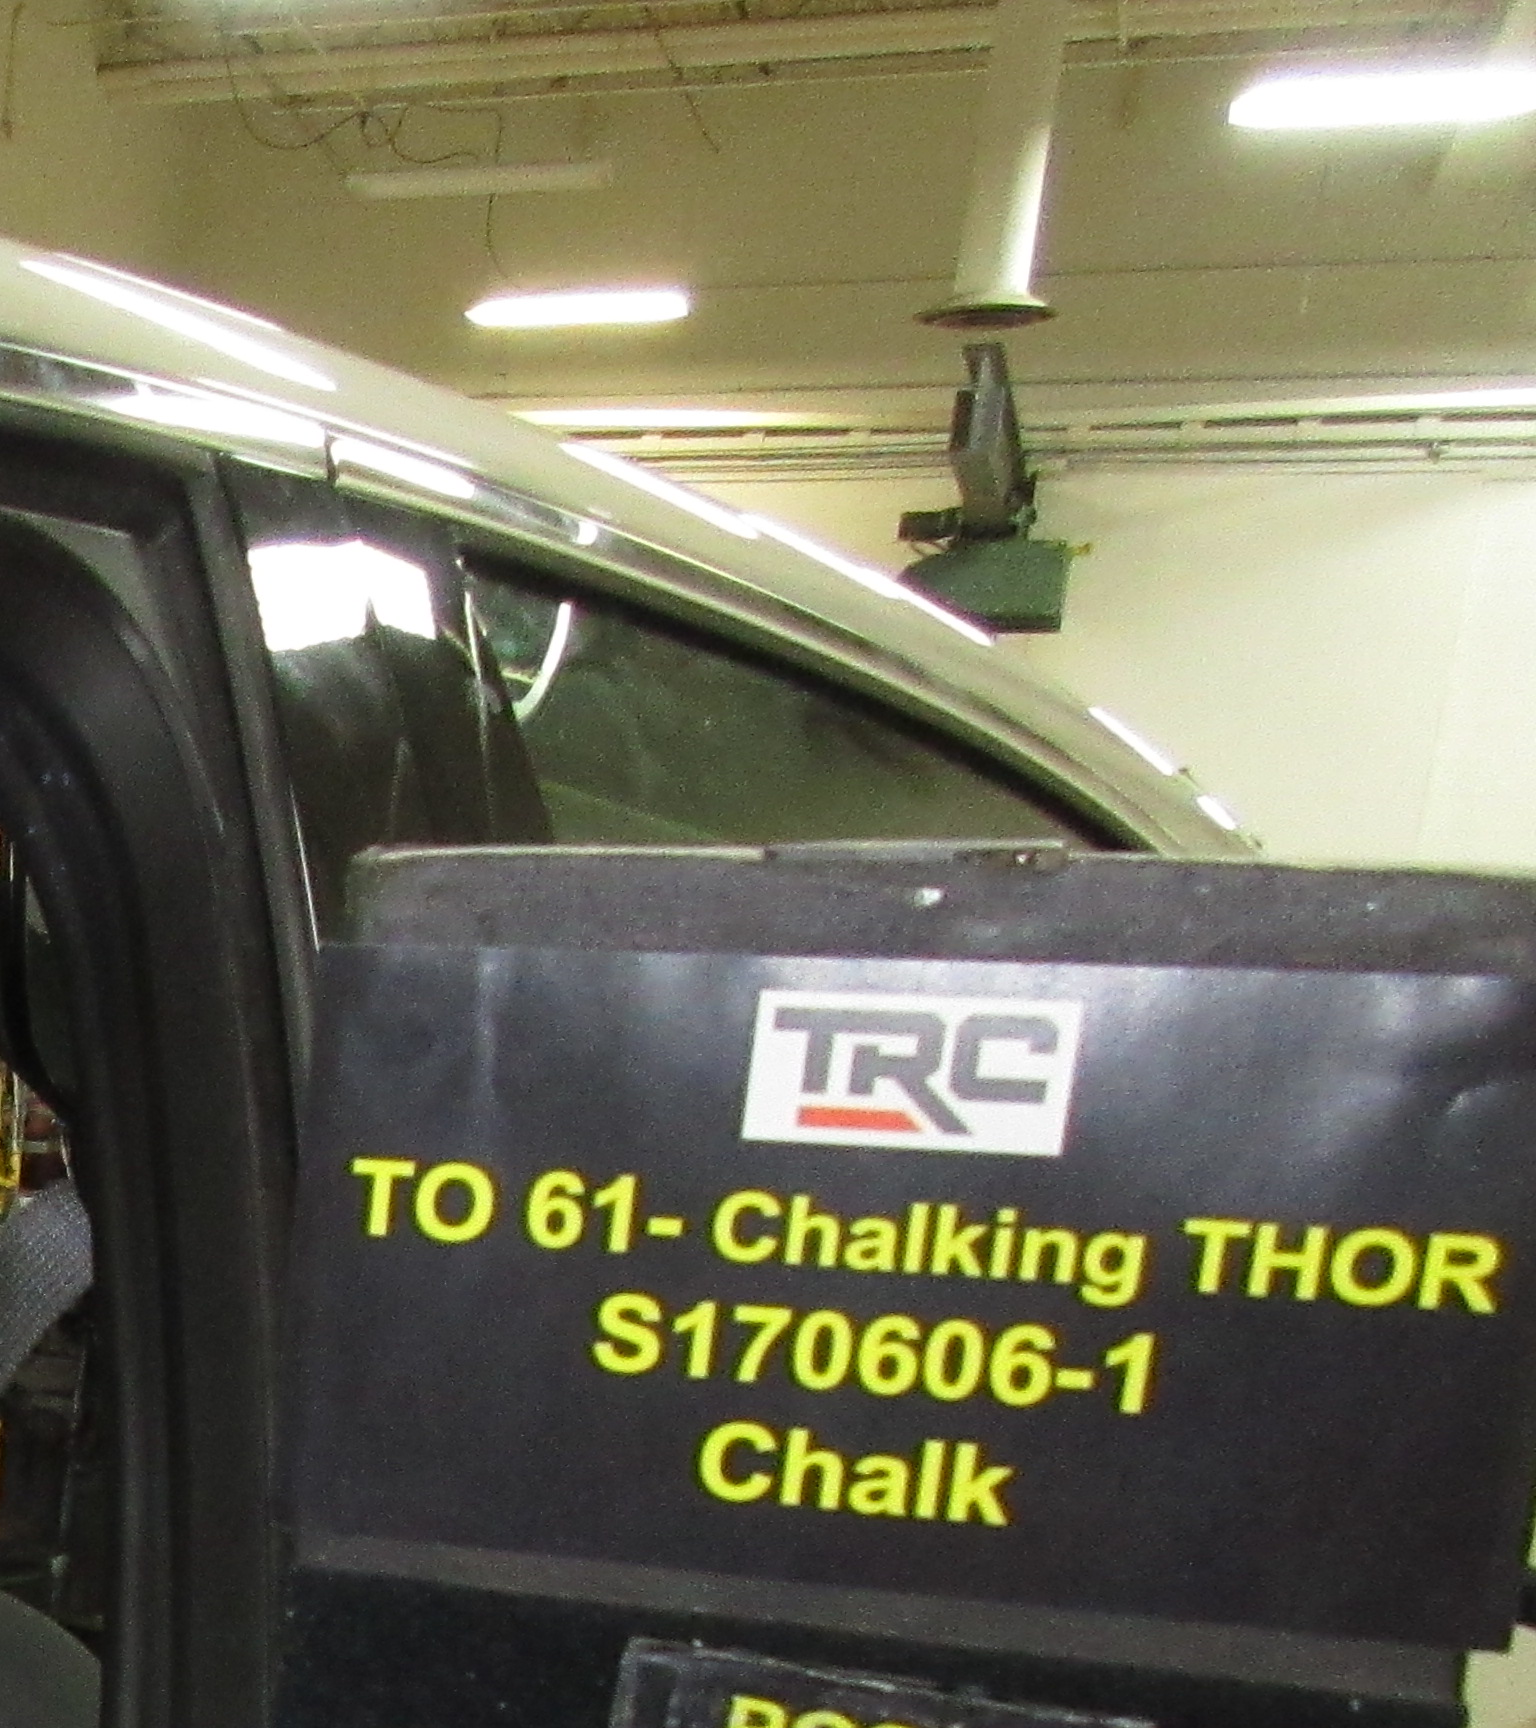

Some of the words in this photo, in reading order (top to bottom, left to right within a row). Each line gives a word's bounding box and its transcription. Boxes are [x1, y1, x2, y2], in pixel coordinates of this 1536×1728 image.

[774, 1006, 1060, 1136] TRC
[351, 1156, 496, 1244] TO
[526, 1168, 684, 1254] 61-
[711, 1189, 1148, 1308] Chalking
[1182, 1217, 1502, 1314] THOR
[591, 1292, 1156, 1415] S170606-1
[698, 1420, 1014, 1526] Chalk
